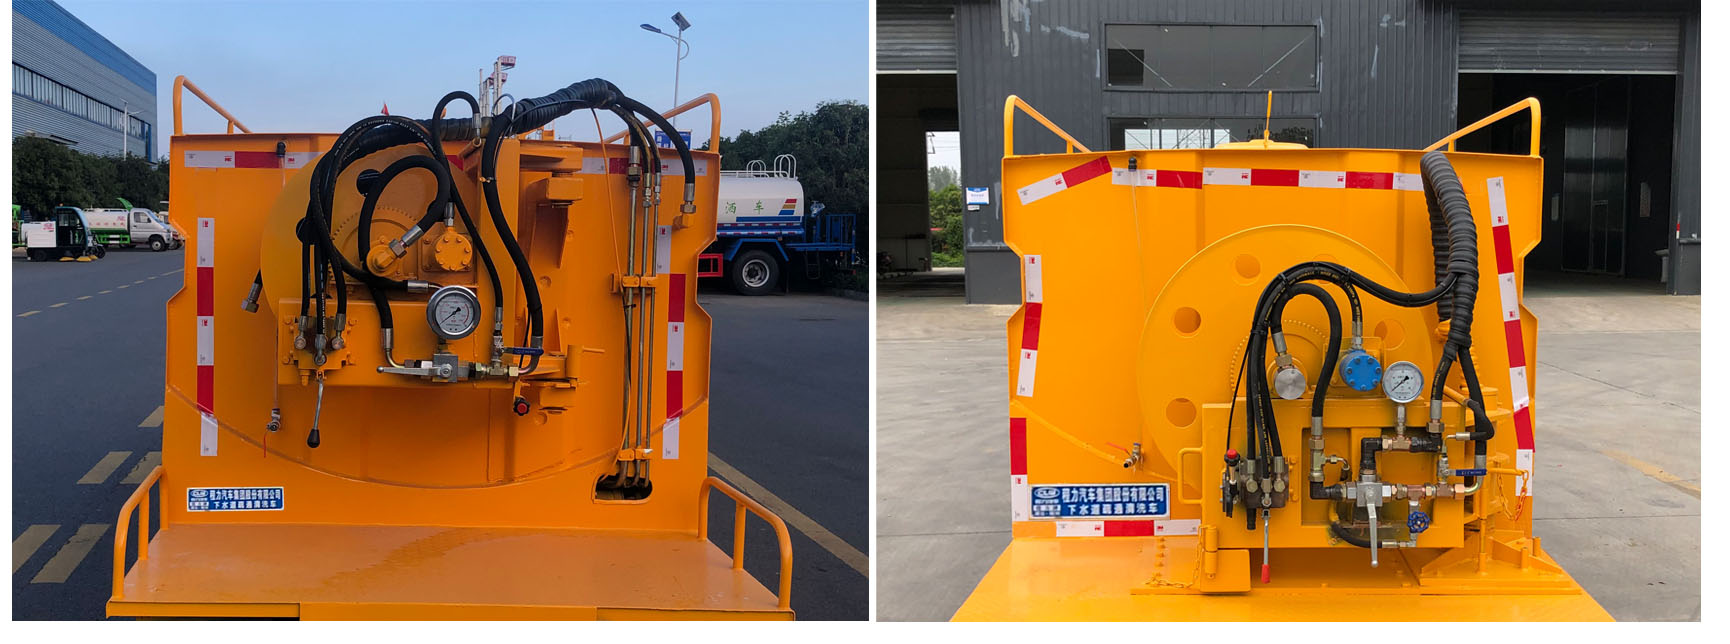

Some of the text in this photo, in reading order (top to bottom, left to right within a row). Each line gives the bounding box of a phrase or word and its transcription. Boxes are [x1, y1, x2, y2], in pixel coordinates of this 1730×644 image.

[1062, 487, 1164, 503] 程力汽车集团股份有限公司
